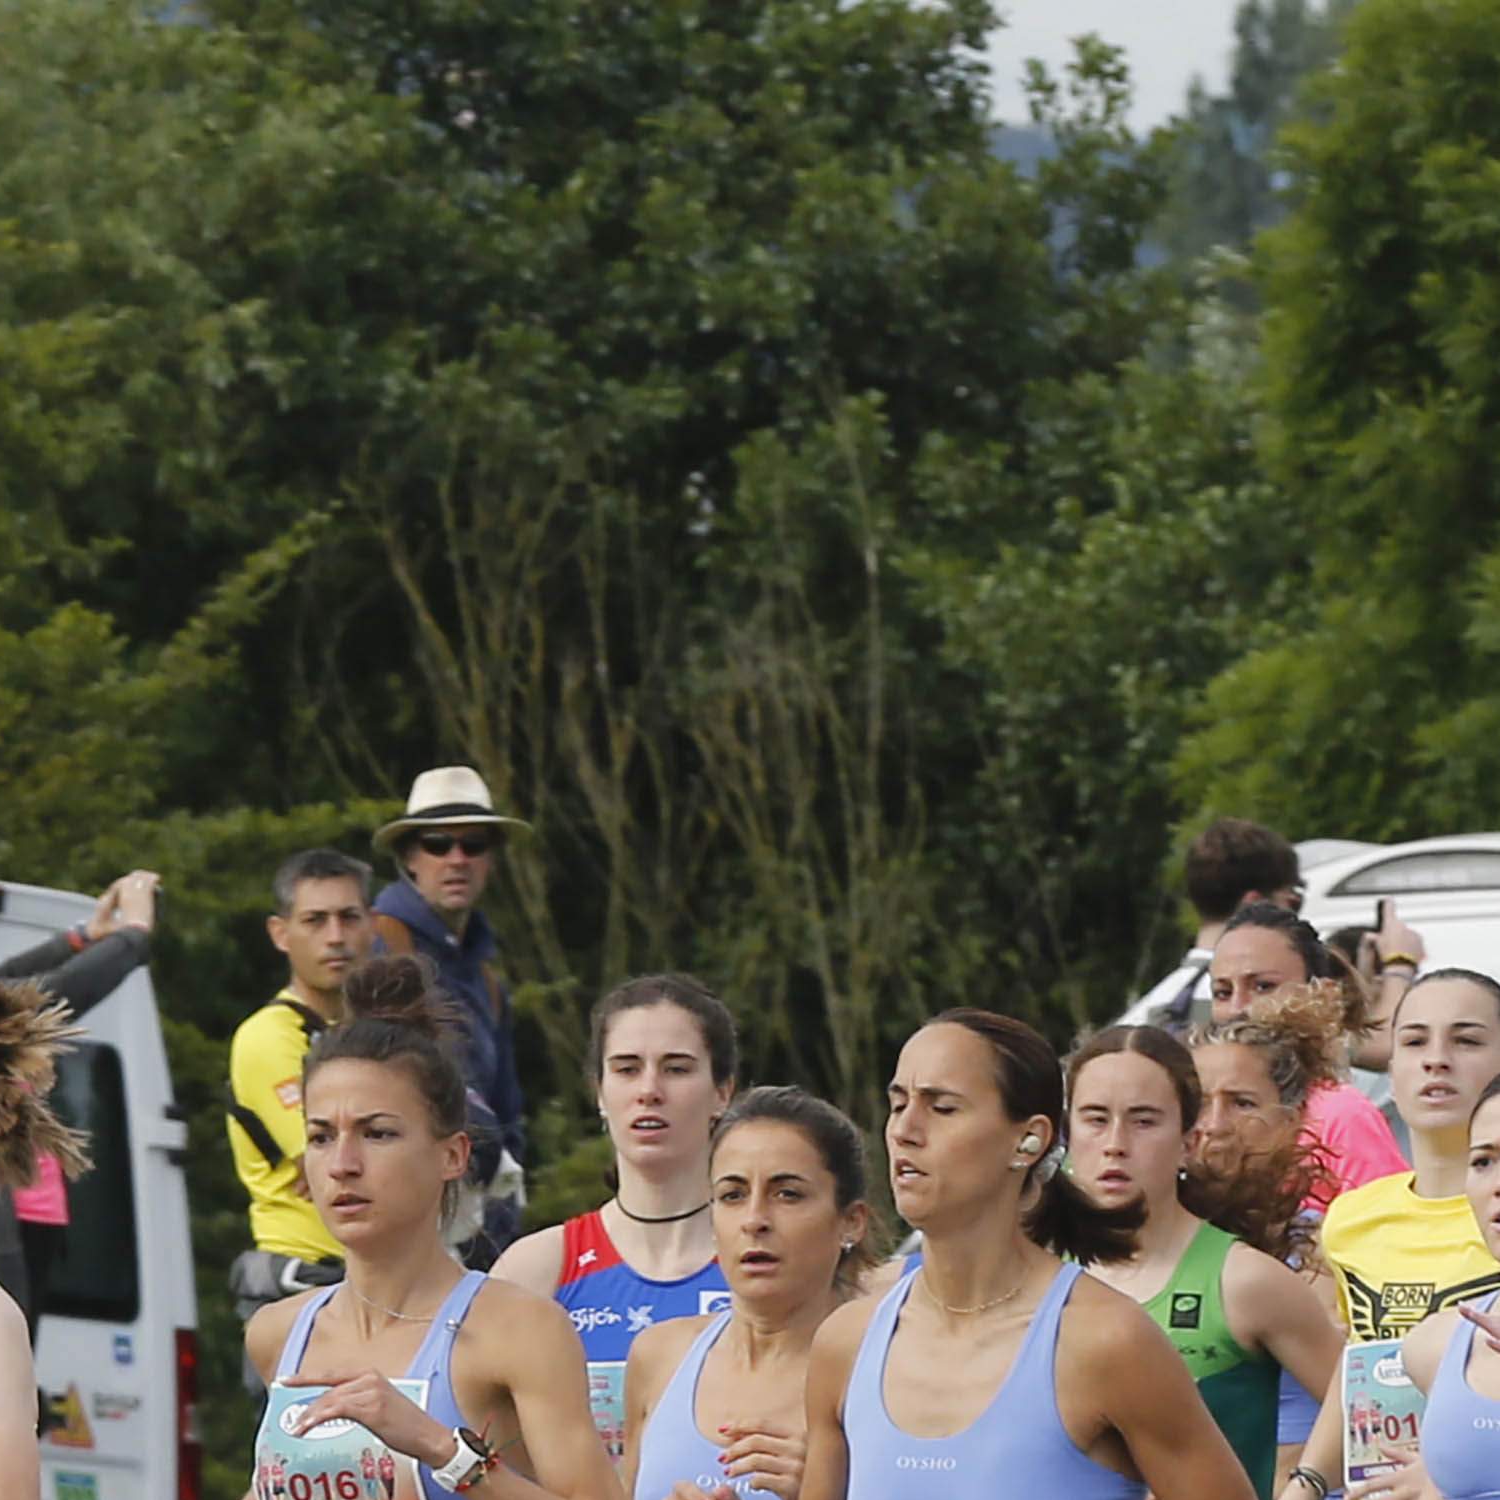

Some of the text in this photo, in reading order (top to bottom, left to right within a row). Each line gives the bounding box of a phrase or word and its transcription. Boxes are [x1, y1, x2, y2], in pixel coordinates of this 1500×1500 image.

[1384, 1285, 1431, 1307] BORN
[1384, 1412, 1419, 1441] 01
[895, 1455, 957, 1471] OYSHO
